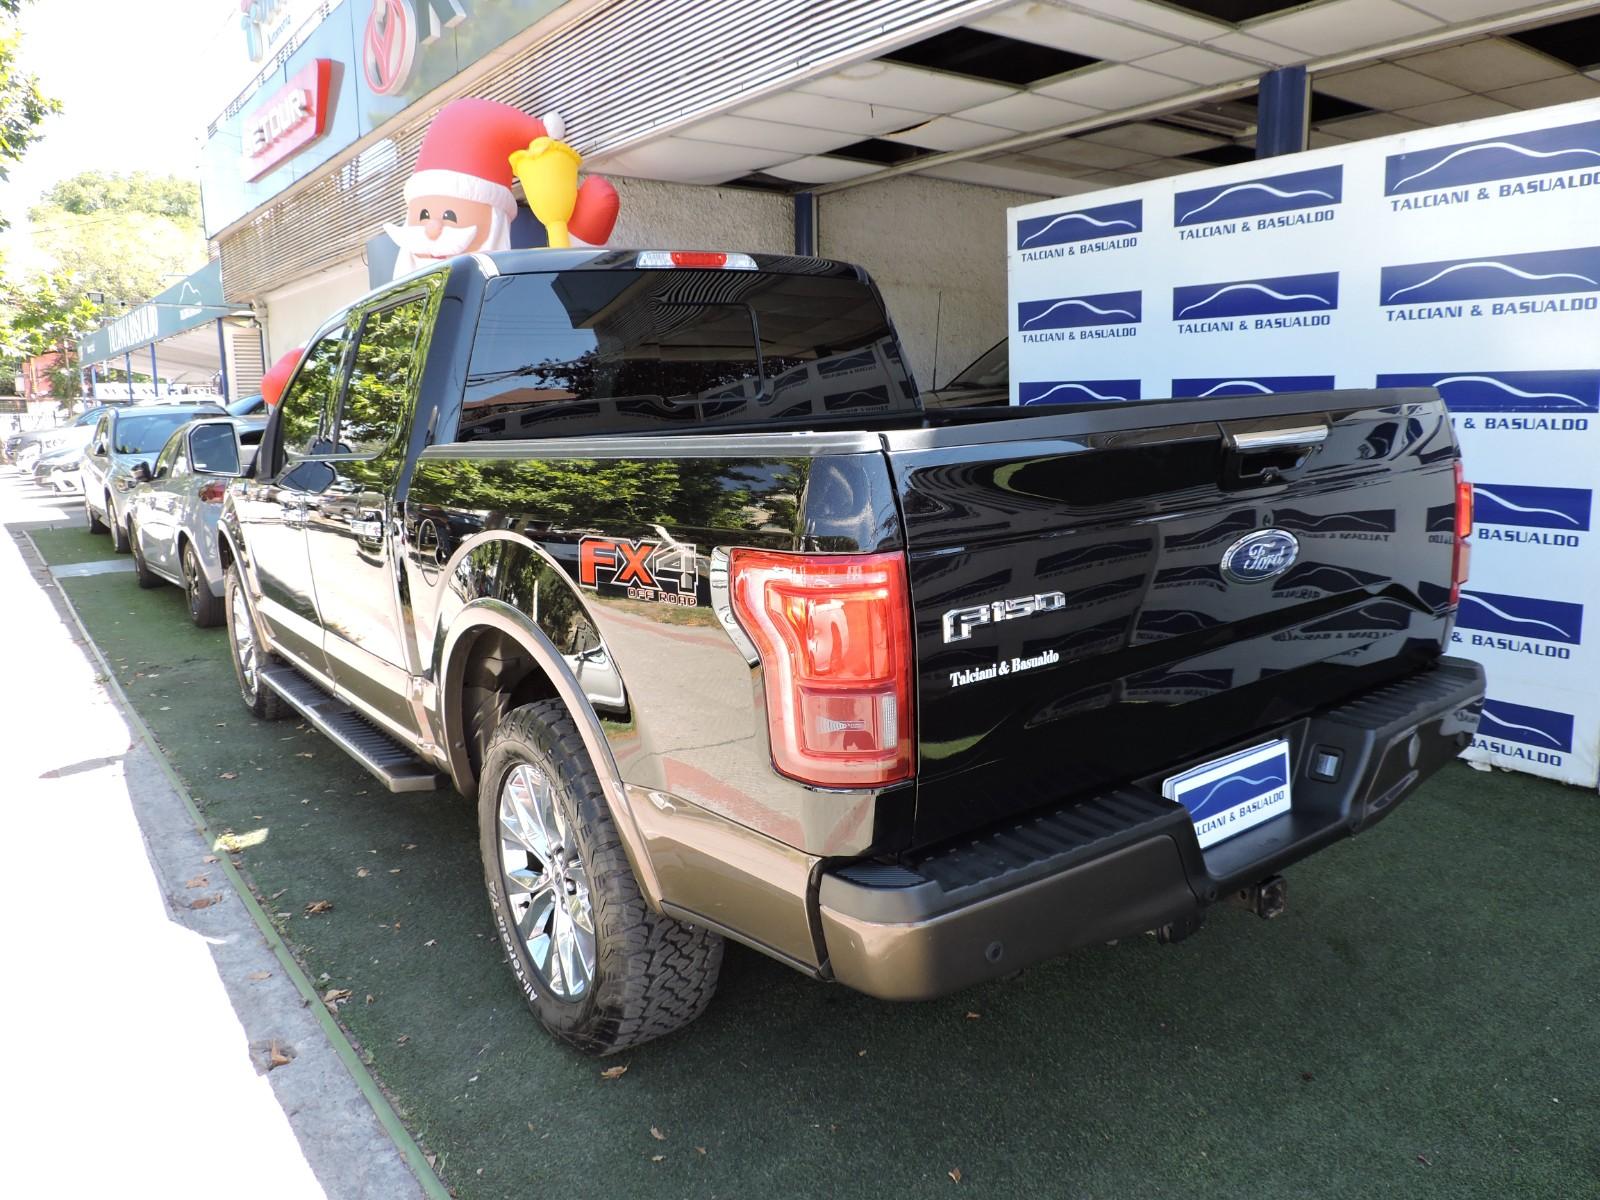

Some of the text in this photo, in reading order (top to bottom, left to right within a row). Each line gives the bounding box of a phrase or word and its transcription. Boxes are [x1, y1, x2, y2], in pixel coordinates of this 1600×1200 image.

[243, 89, 306, 156] ETOUR
[1391, 190, 1470, 212] TALCIANI
[1477, 188, 1490, 200] &
[1179, 209, 1334, 241] TALCIANI & BASUALDO
[1022, 237, 1137, 262] TALCIANI & BASUALDO
[1386, 297, 1598, 322] TALCIANI & BASUALDO
[1022, 327, 1137, 343] TALCIANI & BASUALDO
[1178, 314, 1331, 334] TALCIANI & BASUALDO
[1464, 418, 1476, 429] &
[1485, 418, 1588, 431] BASUALDO
[1478, 528, 1580, 547] BASUALDO
[578, 535, 698, 596] FX4
[1244, 541, 1286, 570] Ford
[627, 586, 697, 607] OFF ROAD
[942, 591, 1066, 644] F150
[1451, 632, 1570, 660] & BASUALDO
[949, 649, 1060, 688] Talciani & Basualdo
[1197, 790, 1285, 836] LCIANI & BASUALDO
